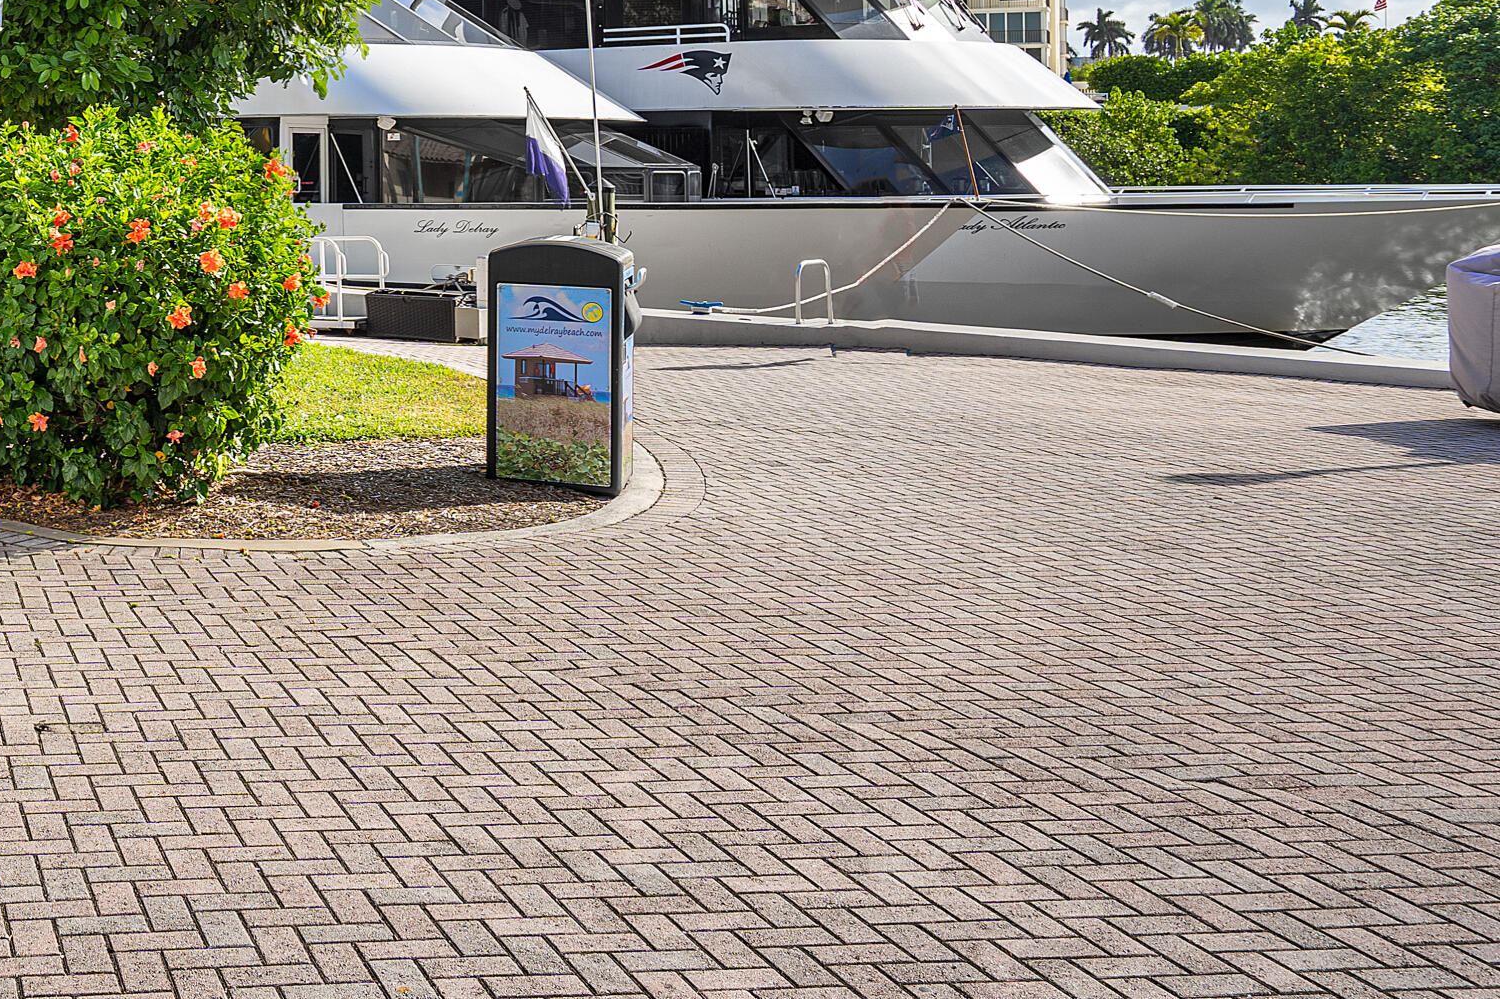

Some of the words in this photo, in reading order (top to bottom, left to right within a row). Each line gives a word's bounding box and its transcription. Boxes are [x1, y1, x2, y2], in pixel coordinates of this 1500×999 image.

[413, 219, 449, 238] Lady
[452, 219, 499, 238] Delray
[959, 219, 988, 235] ady
[506, 324, 603, 338] www.mydelraybeach.com
